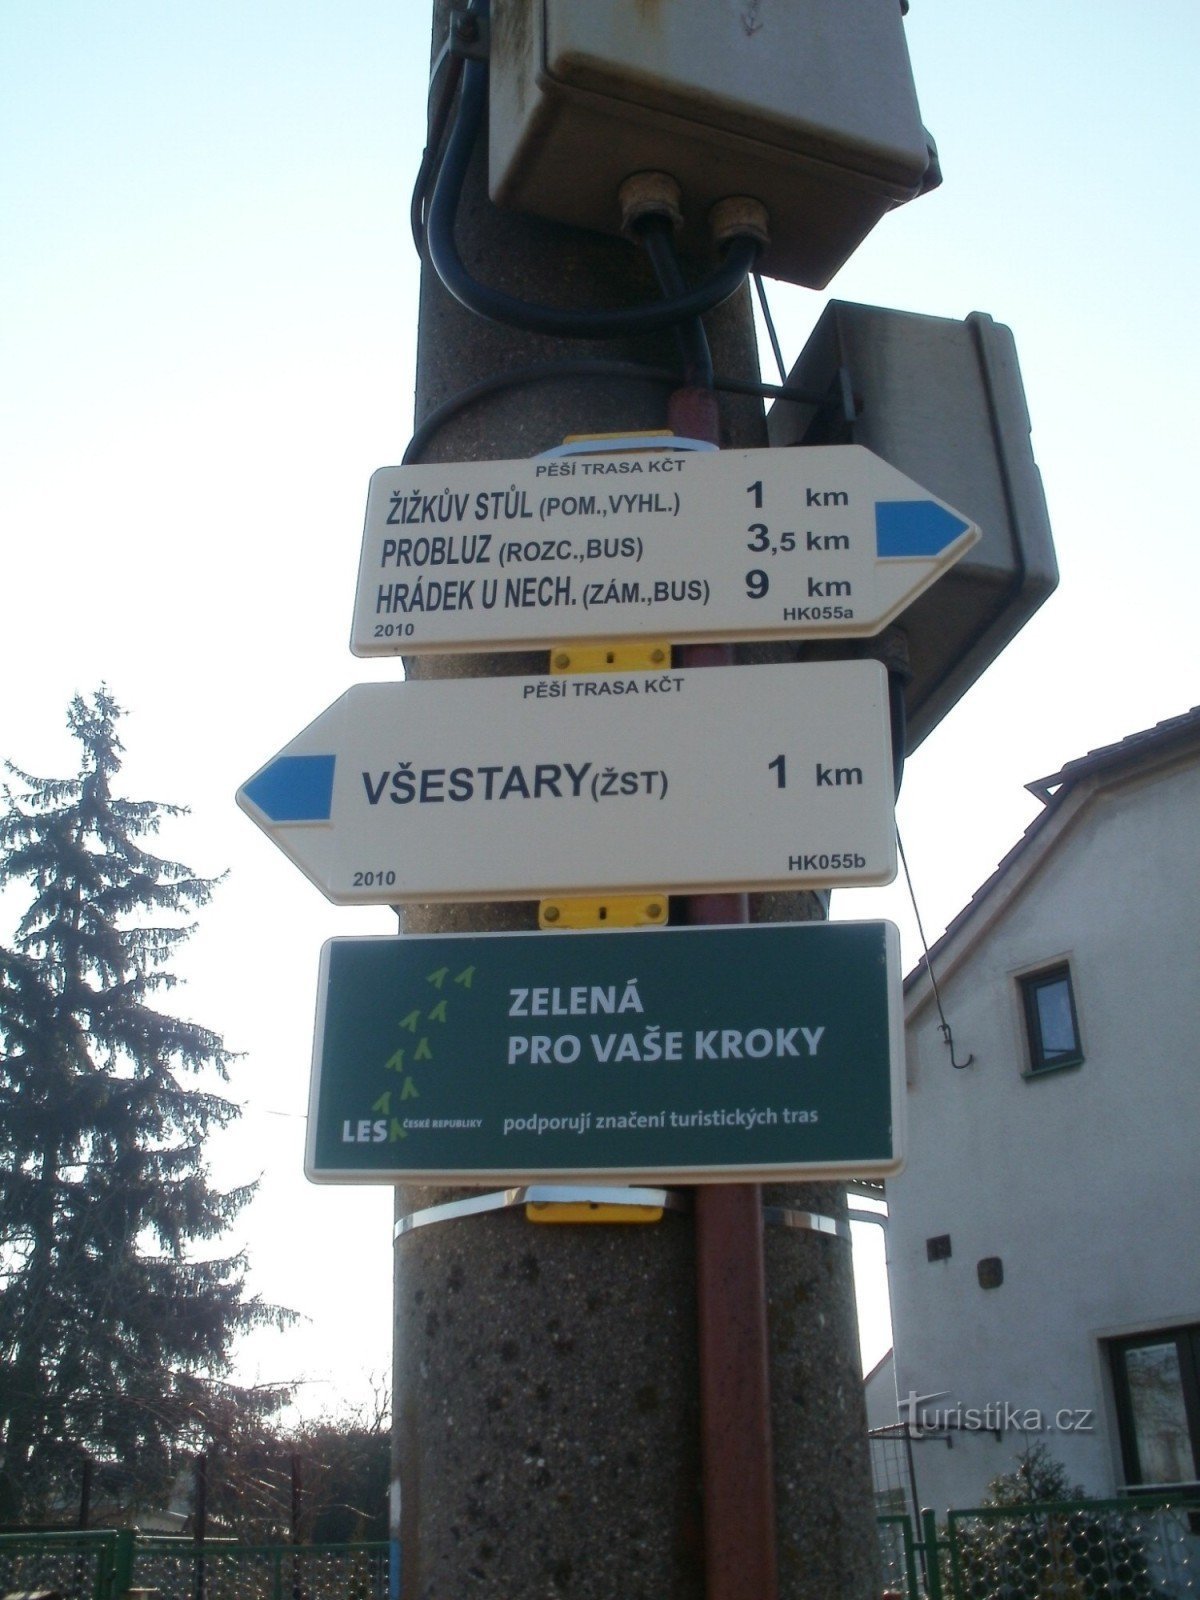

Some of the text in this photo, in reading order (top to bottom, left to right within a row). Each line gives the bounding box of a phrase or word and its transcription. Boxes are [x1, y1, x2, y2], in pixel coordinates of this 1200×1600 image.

[535, 458, 686, 478] PĚŠÍ TRASA KČT
[385, 487, 470, 525] ŽIŽKŮV
[474, 484, 533, 522] STŮL
[746, 480, 763, 508] 1
[805, 488, 849, 507] km
[381, 534, 493, 568] PROBLUZ
[806, 531, 850, 551] km
[376, 575, 476, 614] HRÁDEK
[482, 580, 498, 609] U
[504, 576, 577, 608] NECH.
[745, 569, 770, 600] 9
[807, 577, 852, 597] km
[783, 607, 854, 621] HK055a
[373, 623, 415, 638] 2010
[522, 677, 685, 699] PĚŠÍ TRASA KČT
[768, 754, 787, 789] 1
[815, 763, 863, 787] km
[787, 853, 867, 871] HK055b
[352, 870, 396, 887] 2010
[508, 978, 643, 1016] ZELENÁ
[507, 1025, 826, 1065] PRO VAŠE KROKY
[432, 1118, 483, 1128] REPUBLIKY
[502, 1106, 819, 1136] podporují značení turistických tras
